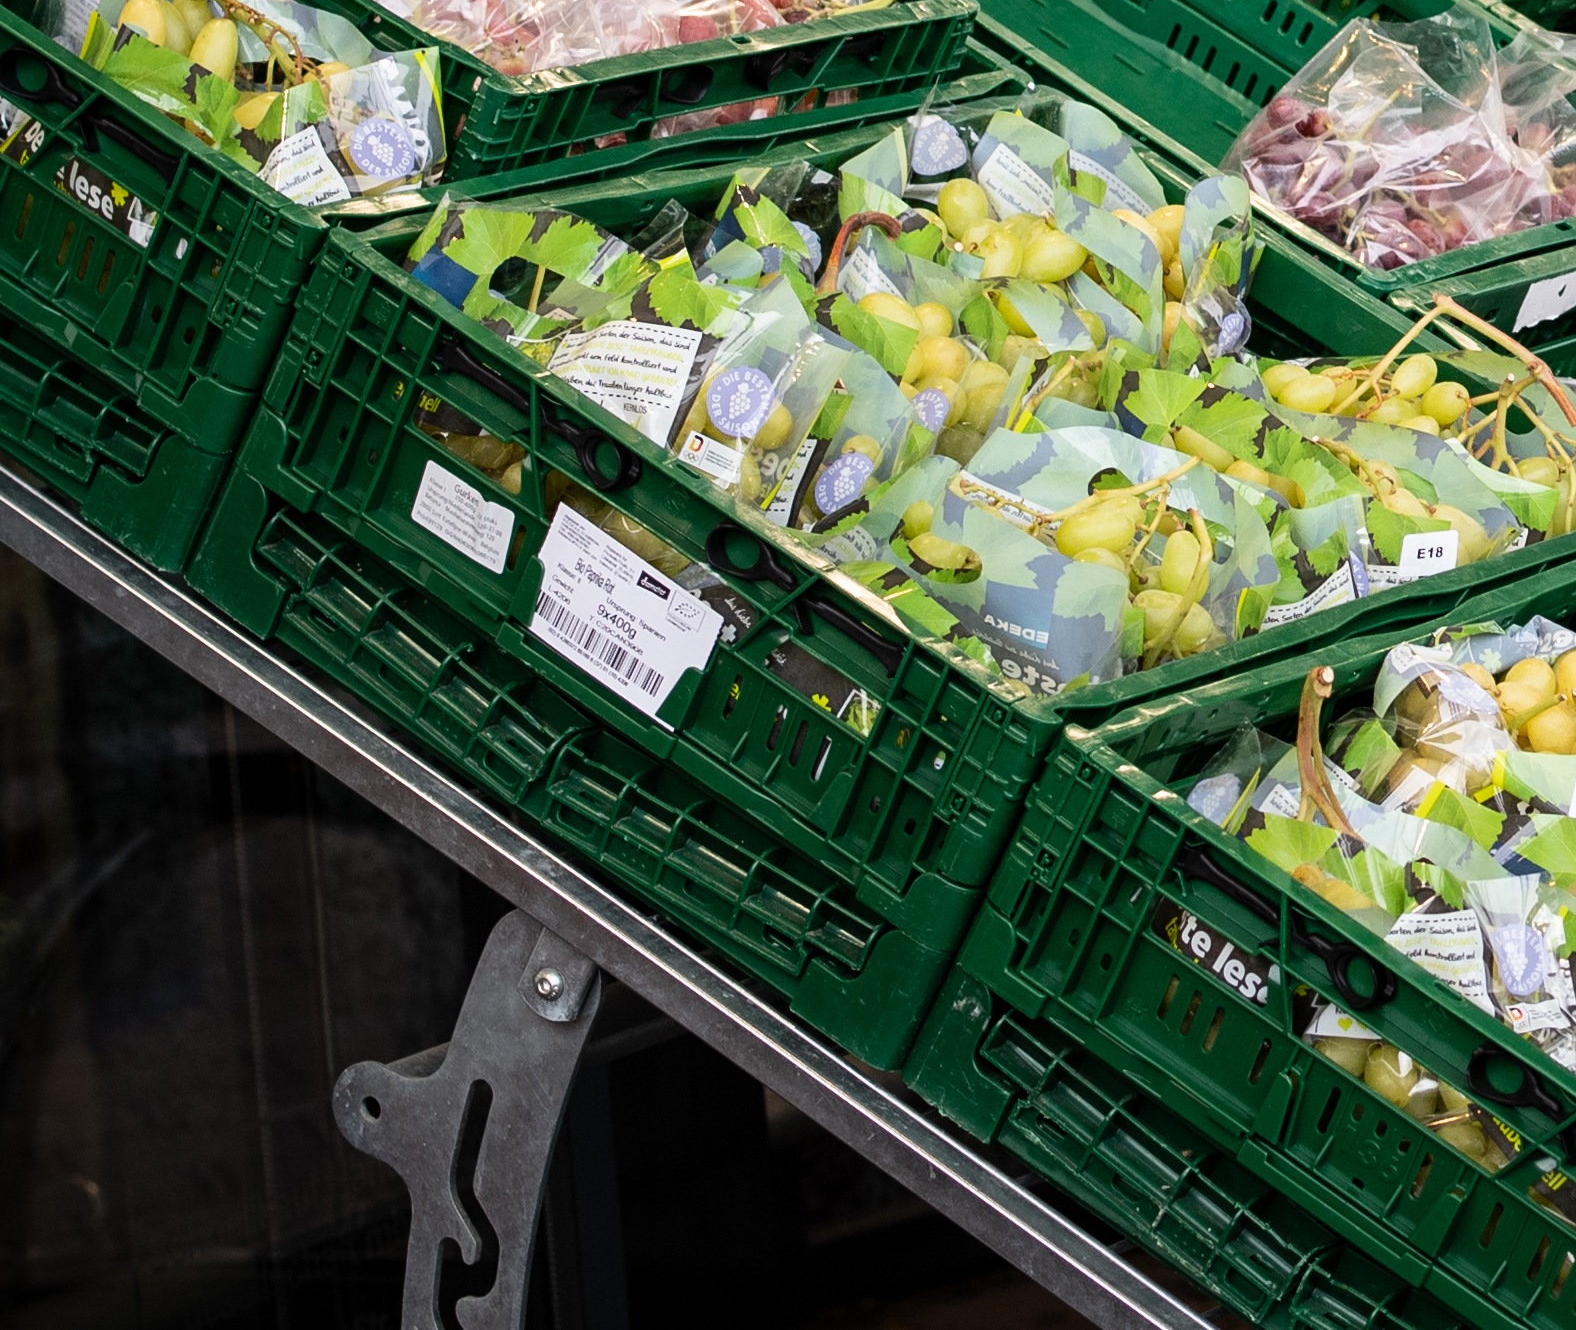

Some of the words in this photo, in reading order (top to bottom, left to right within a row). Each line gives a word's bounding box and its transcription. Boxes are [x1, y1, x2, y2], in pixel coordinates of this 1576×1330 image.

[354, 133, 366, 151] DIE
[361, 158, 381, 177] DER
[384, 147, 412, 178] SAISON
[69, 159, 114, 221] lese
[278, 170, 310, 193] ontrolliert
[659, 337, 673, 348] das
[674, 340, 691, 351] sind
[604, 352, 619, 363] Feld
[621, 355, 661, 371] kontrolliert
[662, 365, 677, 375] und
[721, 371, 741, 387] DIE
[743, 371, 770, 414] BESTEN
[623, 402, 648, 415] KERNLOS
[711, 393, 722, 419] DER
[827, 459, 842, 476] DIE
[844, 456, 871, 474] BEST
[454, 484, 479, 506] Gurken
[818, 485, 829, 507] DER
[1416, 547, 1444, 559] E18
[574, 557, 587, 575] Bio
[586, 563, 606, 590] Paprika
[602, 579, 616, 596] Rot
[597, 603, 637, 640] 9x400g
[1281, 610, 1304, 623] Sorten
[638, 619, 667, 642] Spanien
